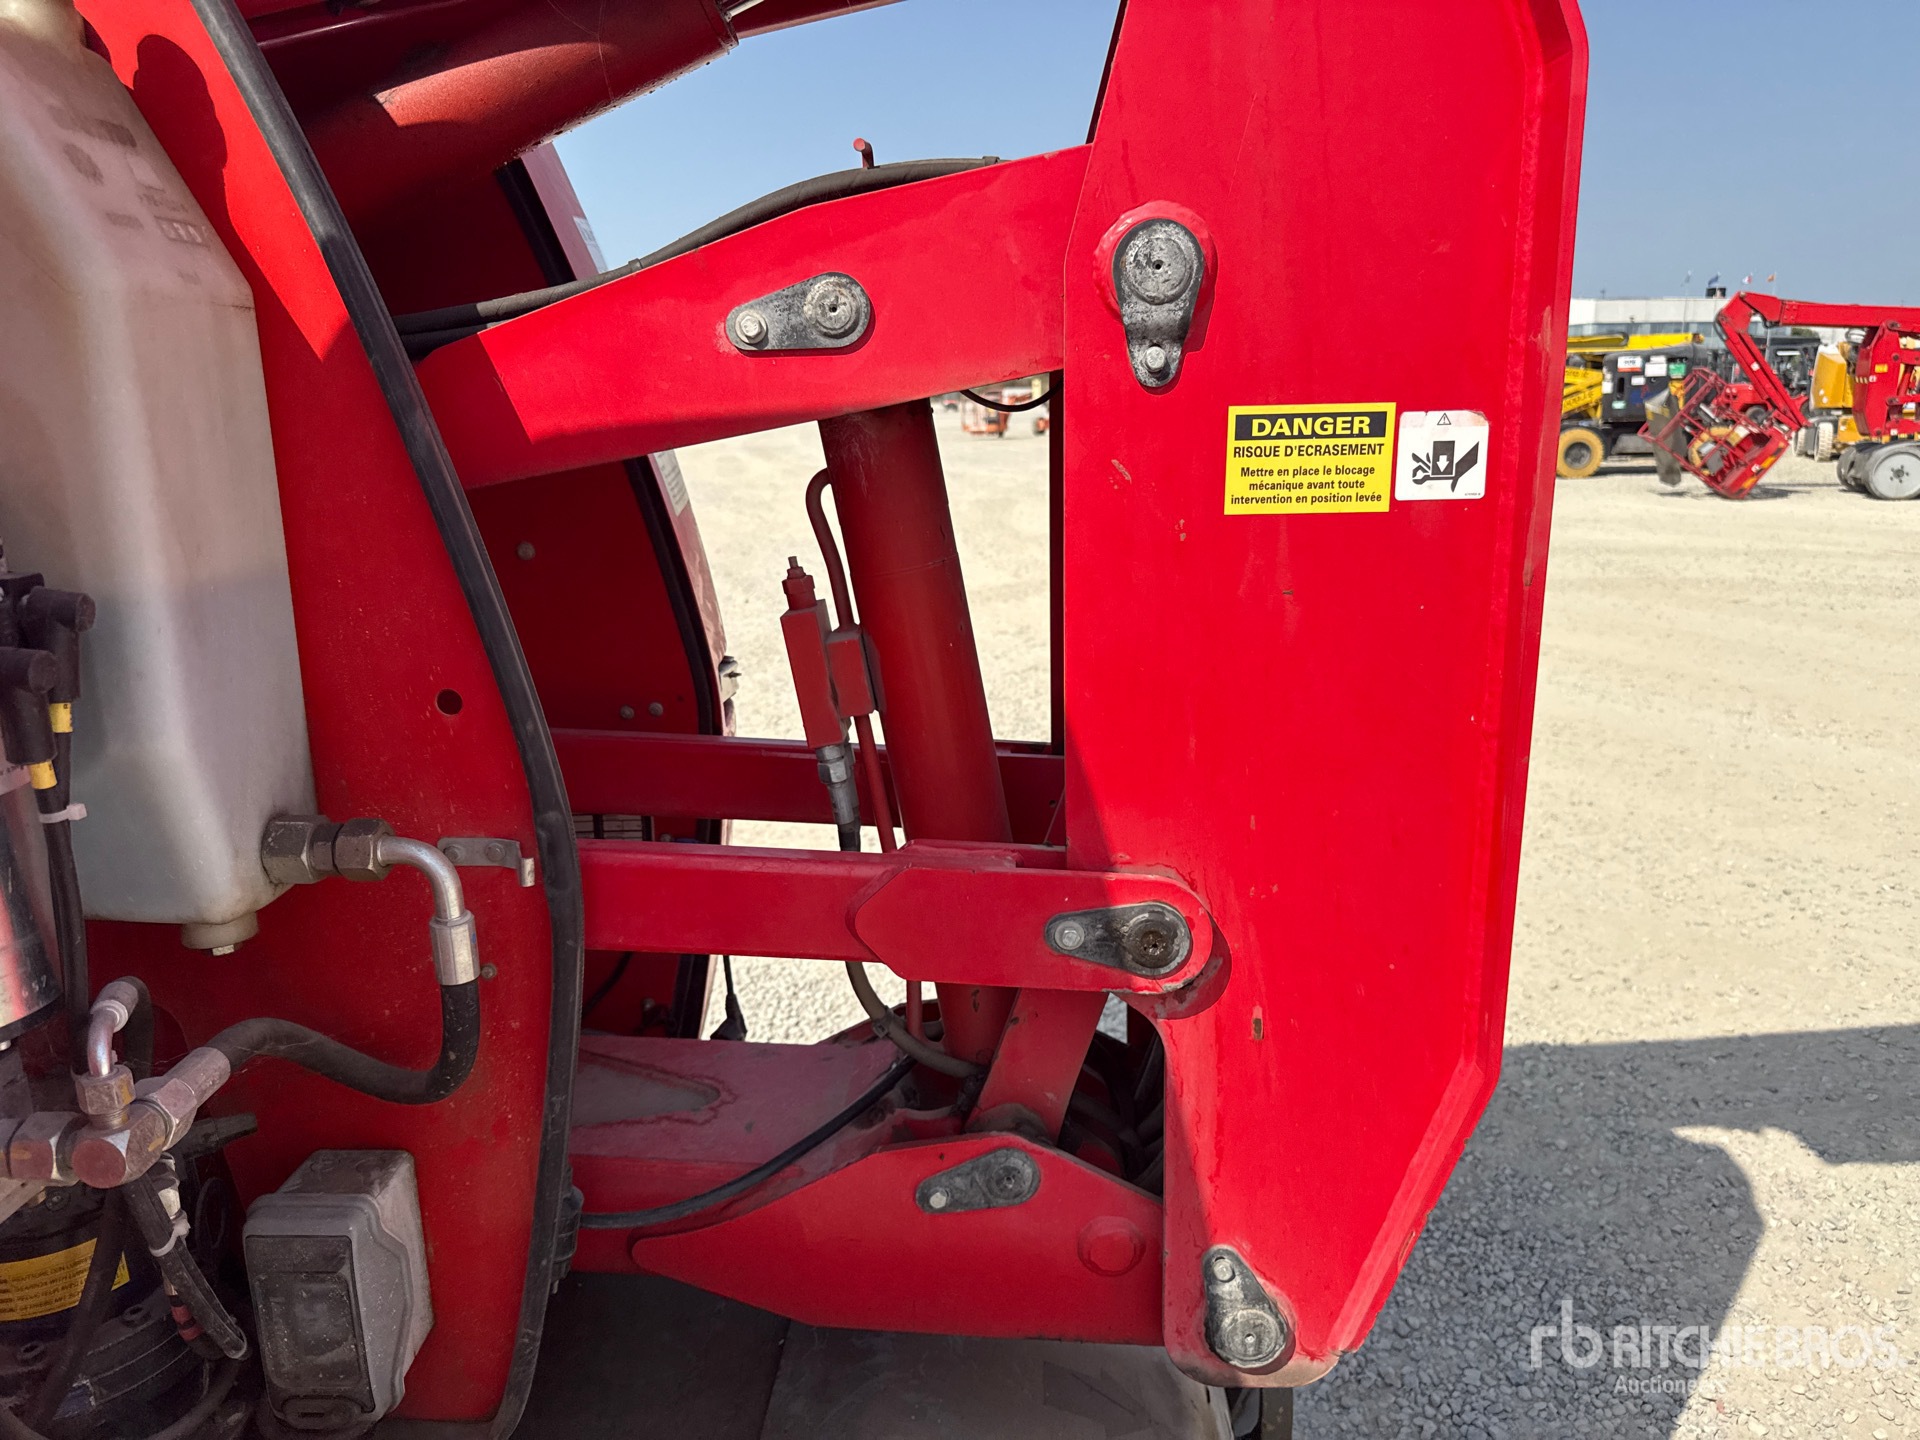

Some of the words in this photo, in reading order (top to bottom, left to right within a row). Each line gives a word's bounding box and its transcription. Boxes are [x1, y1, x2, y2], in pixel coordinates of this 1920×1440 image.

[1251, 415, 1371, 437] DANGER
[1233, 445, 1281, 459] RISQUE
[1284, 443, 1385, 457] D'ECRASEMENT
[1240, 466, 1274, 477] Mettre
[1277, 468, 1290, 477] en
[1292, 465, 1320, 479] place
[1322, 465, 1332, 476] le
[1334, 464, 1375, 477] blocage
[1249, 480, 1304, 493] mécanique
[1306, 480, 1335, 490] avant
[1337, 479, 1365, 489] toute
[1231, 495, 1293, 505] intervention
[1295, 495, 1308, 504] en
[1310, 493, 1353, 506] position
[1355, 492, 1382, 503] levée
